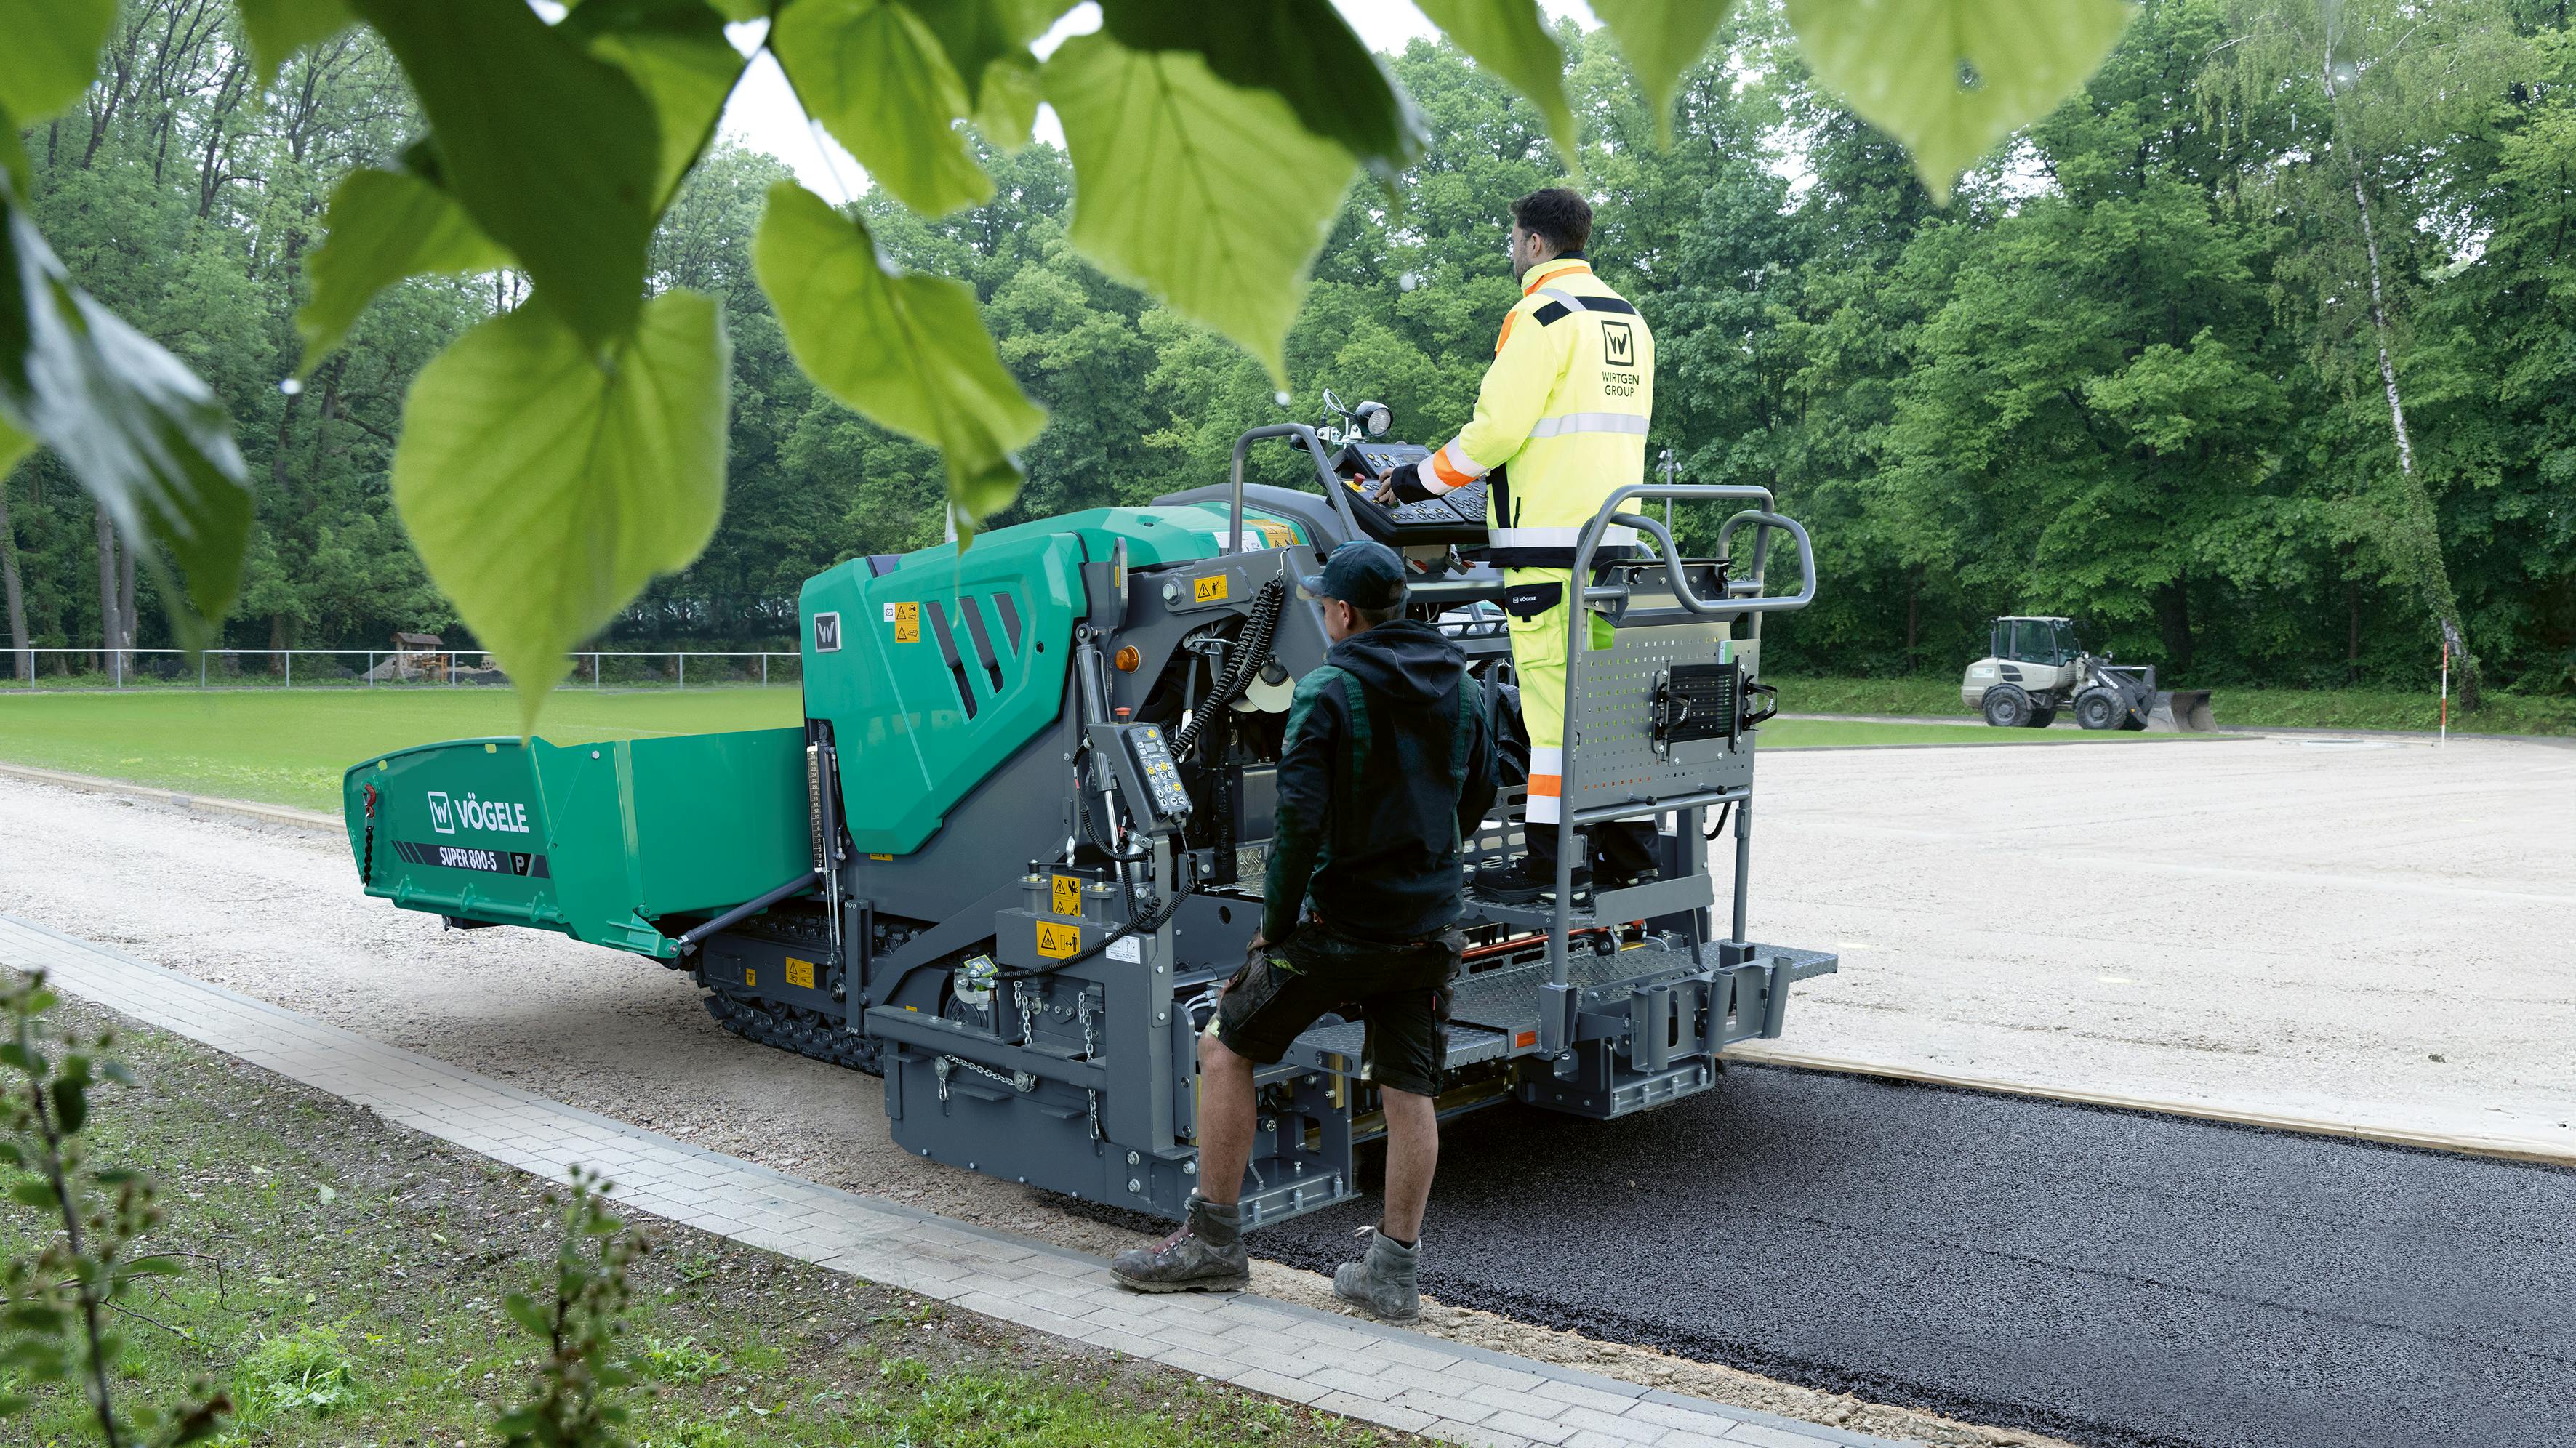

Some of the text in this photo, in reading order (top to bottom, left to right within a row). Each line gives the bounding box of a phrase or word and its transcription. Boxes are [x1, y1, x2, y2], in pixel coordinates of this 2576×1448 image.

[1602, 371, 1640, 385] WIRTGEN
[1605, 385, 1634, 397] GROUP
[2098, 670, 2119, 689] VOLVO
[454, 792, 530, 833] VÖGELE
[439, 846, 524, 872] SUPER 800-5 P
